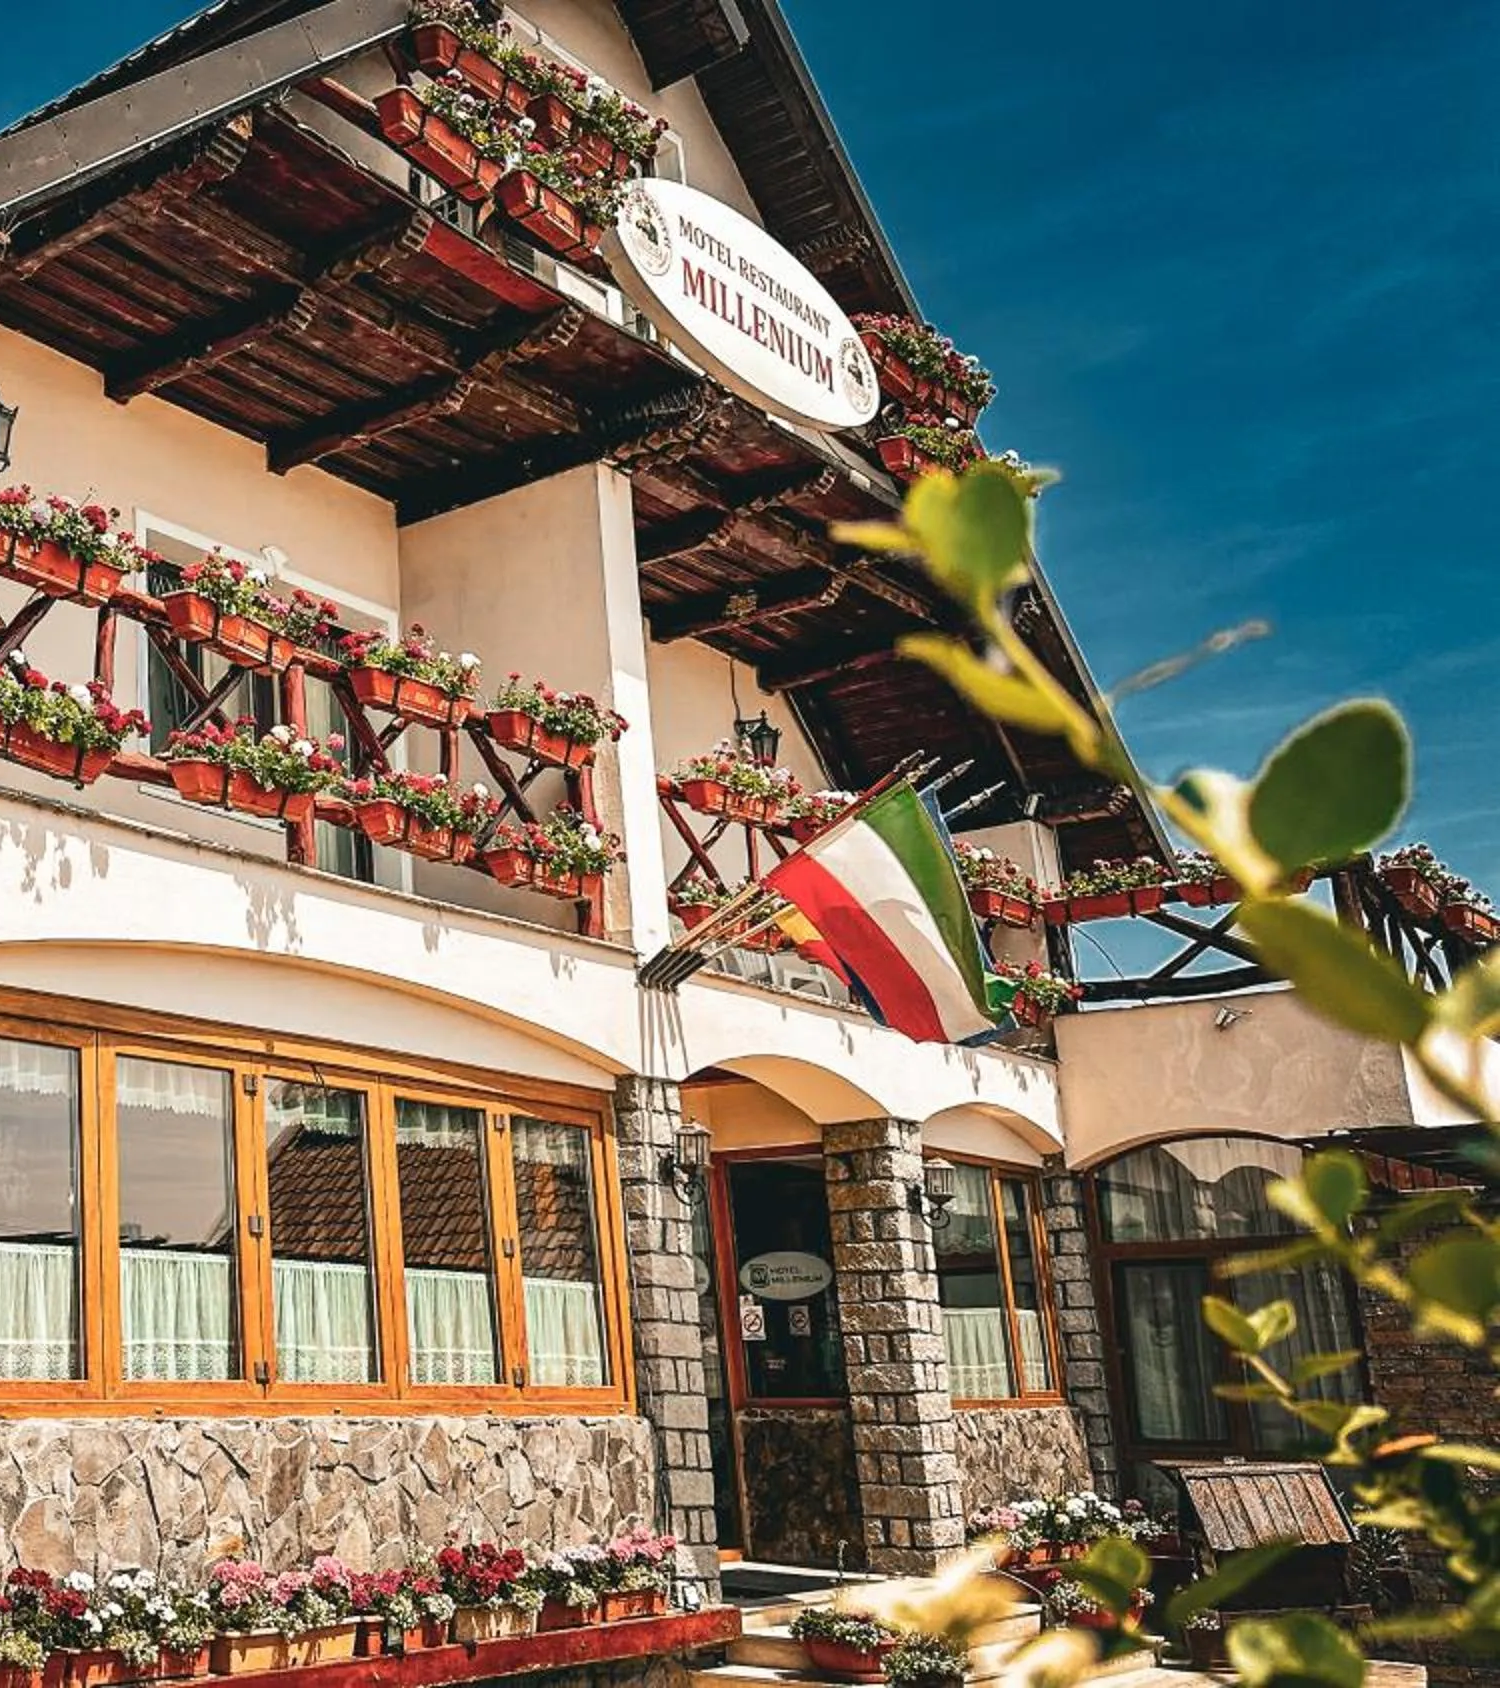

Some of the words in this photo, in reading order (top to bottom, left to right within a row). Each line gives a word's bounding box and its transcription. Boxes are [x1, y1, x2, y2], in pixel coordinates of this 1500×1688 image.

[678, 215, 737, 271] MOTEL
[738, 255, 831, 339] RESTAURANT
[682, 257, 835, 394] MILLENIUM
